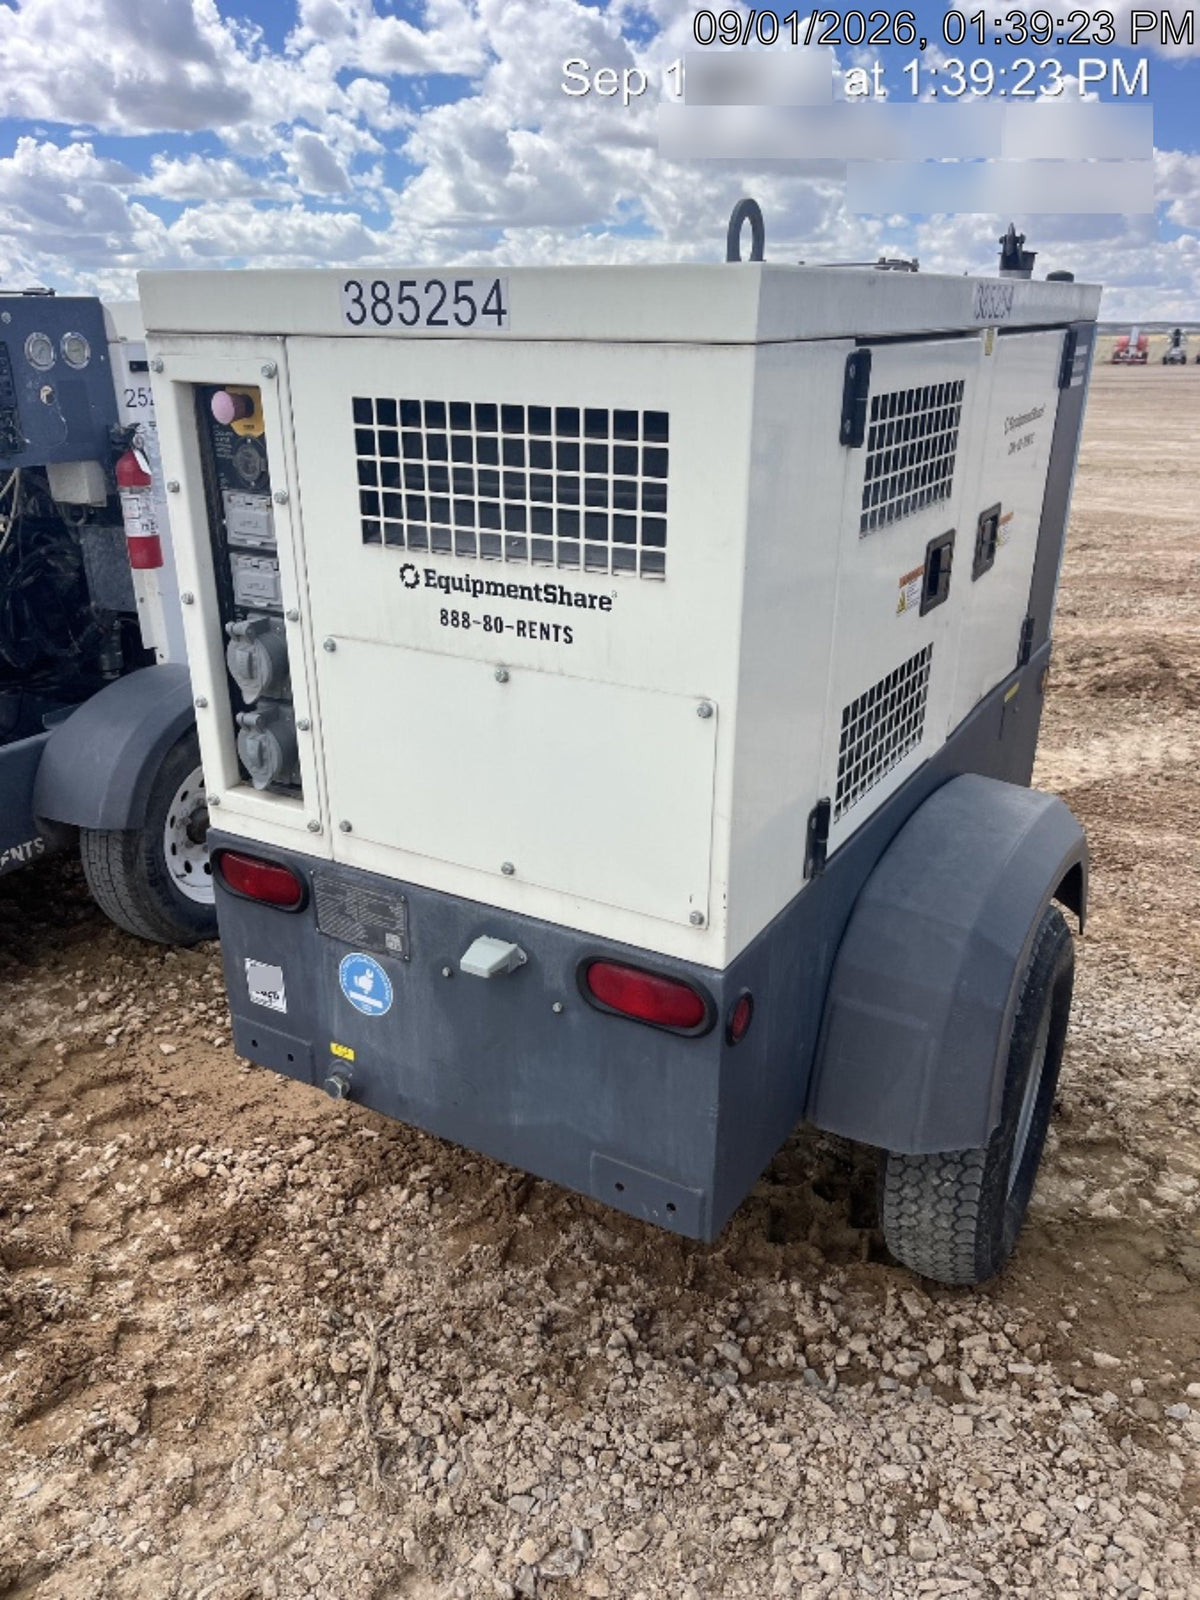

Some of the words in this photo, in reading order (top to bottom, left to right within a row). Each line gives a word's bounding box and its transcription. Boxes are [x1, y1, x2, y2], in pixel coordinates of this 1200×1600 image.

[344, 279, 507, 327] 385254
[423, 568, 613, 613] EquipmentShare
[439, 608, 574, 645] 888-80-RENTS
